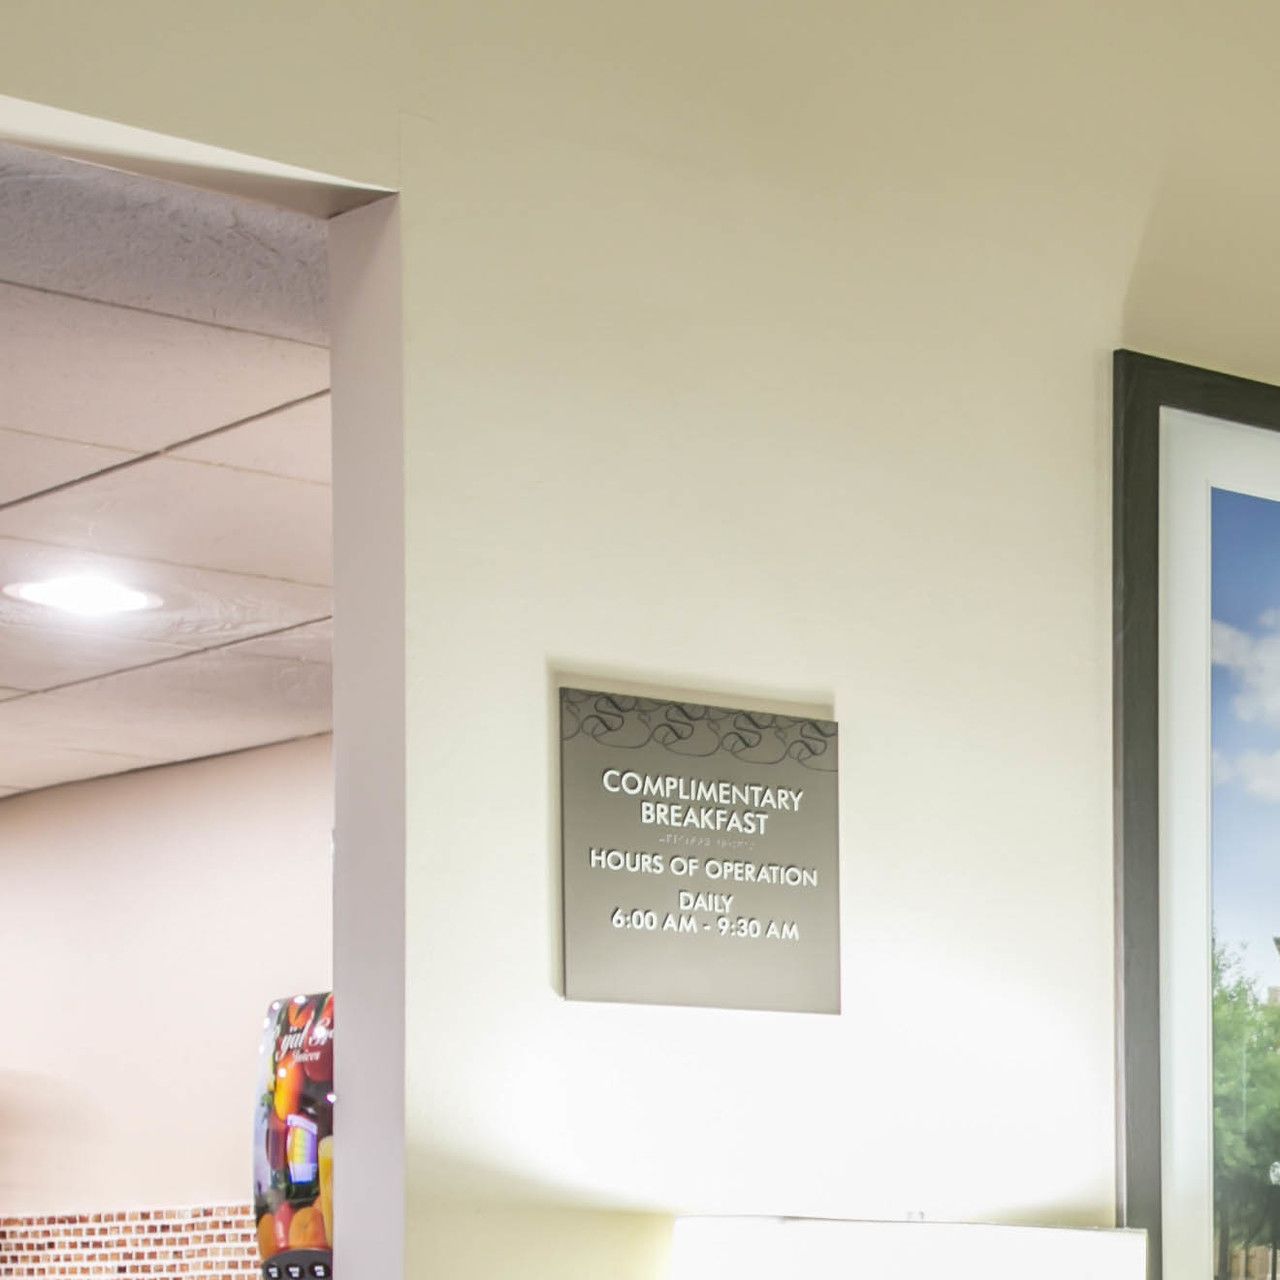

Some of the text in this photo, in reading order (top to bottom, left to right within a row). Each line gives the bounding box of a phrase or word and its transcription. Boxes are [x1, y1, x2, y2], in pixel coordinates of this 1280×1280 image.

[602, 769, 804, 812] COMPLIMENTARY
[641, 801, 769, 835] BREAKFAST
[590, 849, 818, 887] HOURS OF OPERATION
[679, 891, 734, 914] DAILY
[611, 908, 658, 931] 6:00
[663, 914, 698, 933] AM
[717, 917, 761, 938] 9:30
[765, 921, 800, 941] AM
